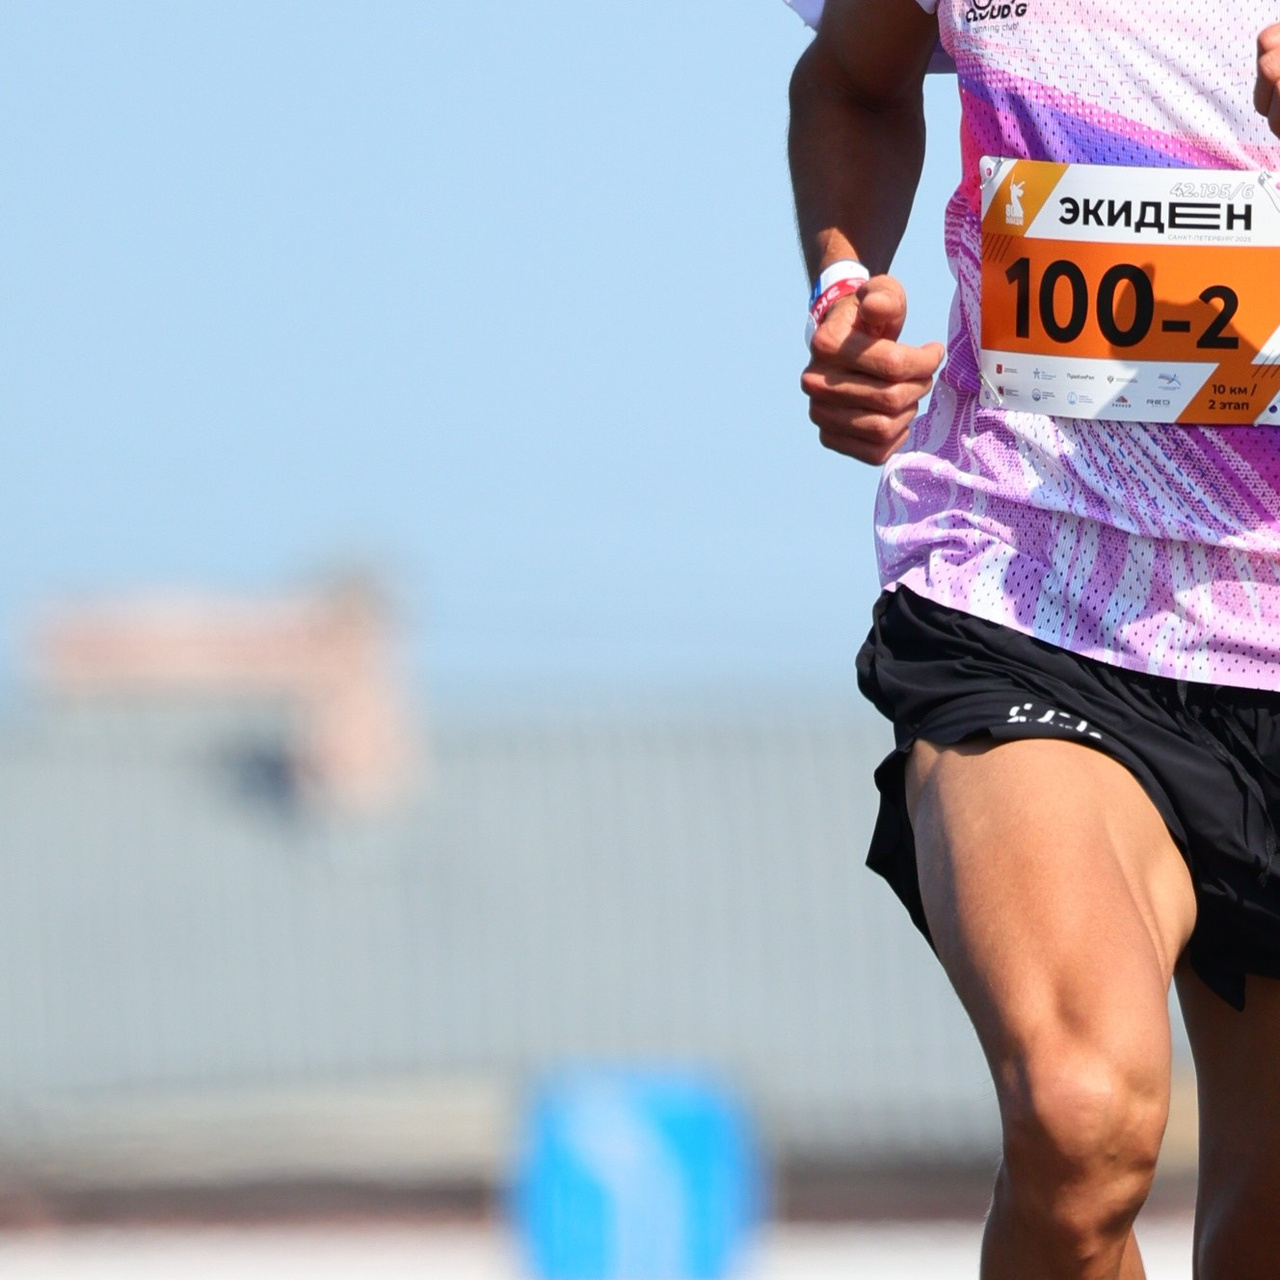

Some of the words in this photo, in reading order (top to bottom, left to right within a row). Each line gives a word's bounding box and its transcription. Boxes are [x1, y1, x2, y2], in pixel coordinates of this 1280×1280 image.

[1015, 3, 1027, 17] G
[1170, 181, 1255, 200] 42.195/6
[1058, 196, 1252, 234] ЭКИДЕН
[1167, 234, 1234, 242] САНКТ-ПЕТЕРБУРГ
[1005, 257, 1239, 349] 100-2
[1212, 384, 1226, 395] 10
[1229, 386, 1248, 395] км
[1208, 399, 1216, 410] 2
[1219, 401, 1250, 411] этап
